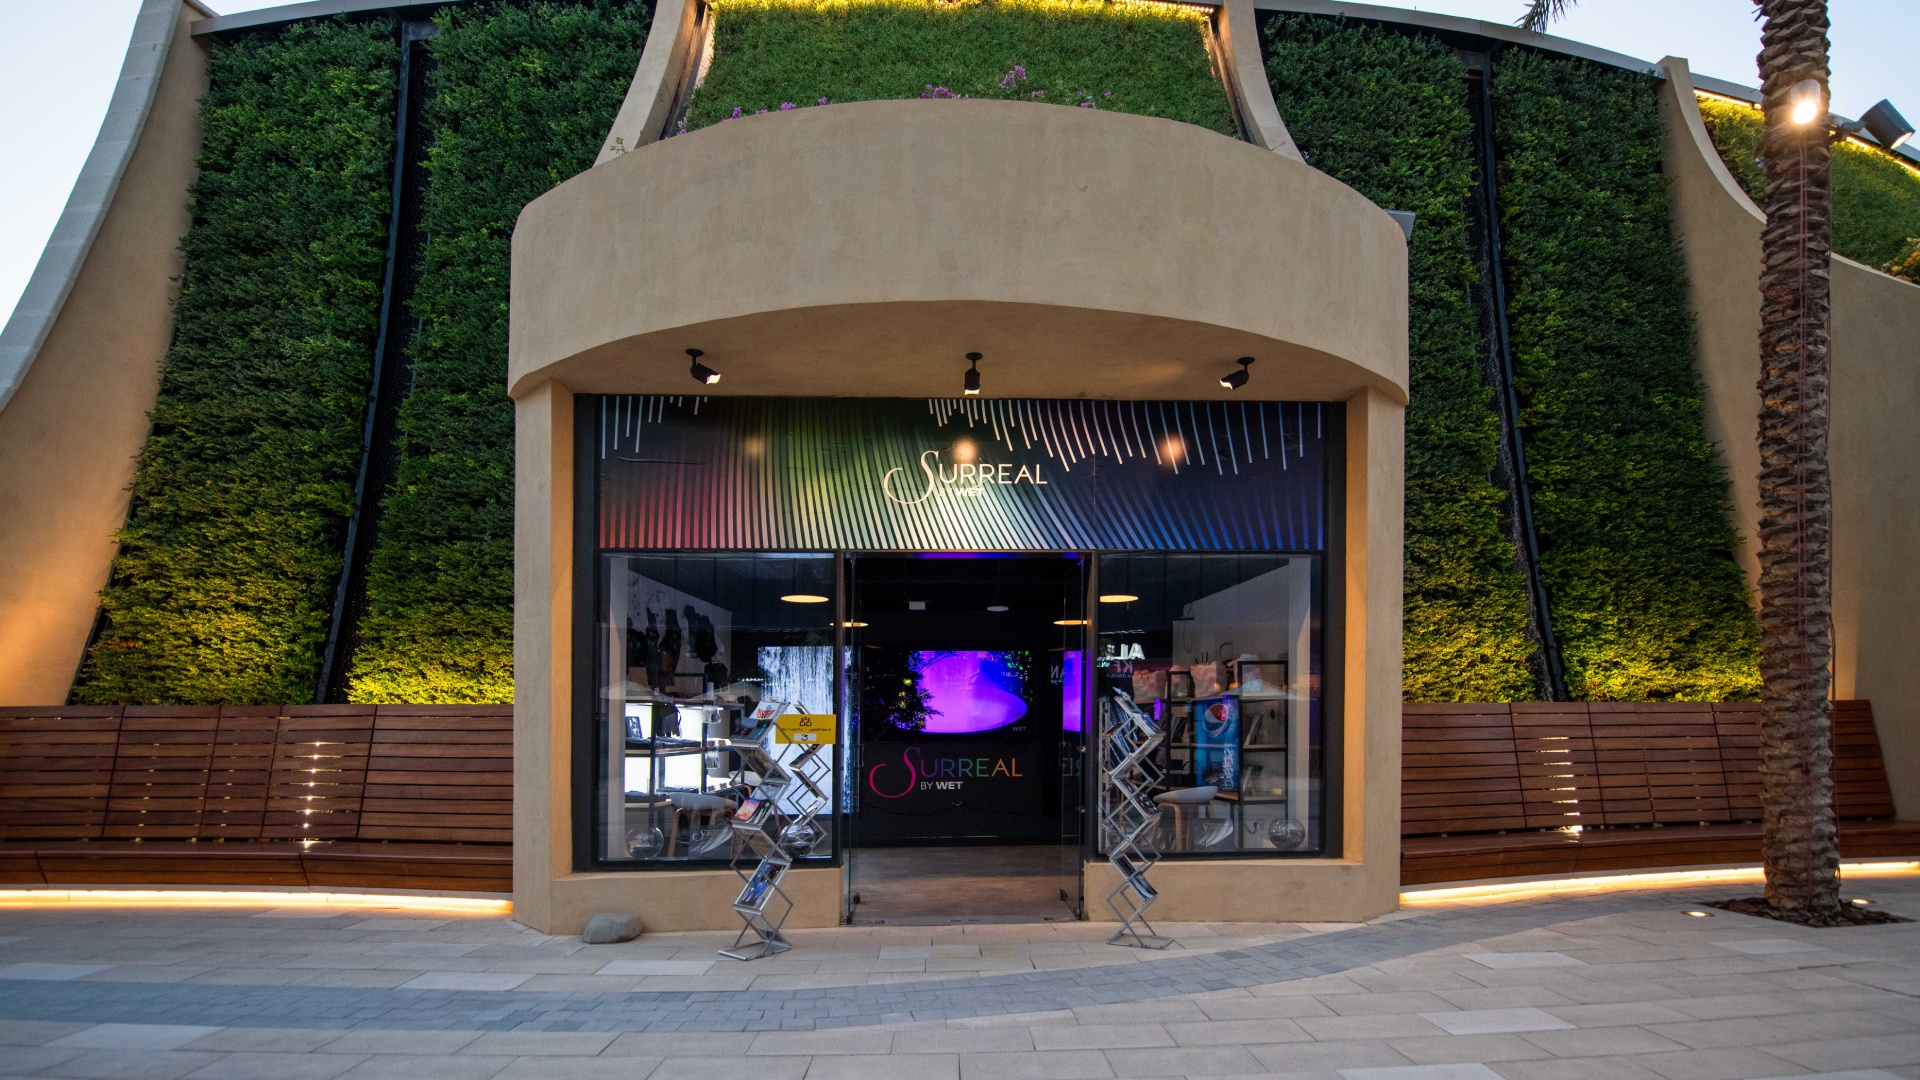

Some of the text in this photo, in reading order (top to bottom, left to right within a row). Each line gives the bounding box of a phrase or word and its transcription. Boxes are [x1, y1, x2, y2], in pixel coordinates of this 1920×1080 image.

[883, 450, 1048, 505] SURREAL
[954, 487, 985, 497] WET
[868, 746, 1023, 798] SURREAL
[920, 781, 964, 790] BY WET
